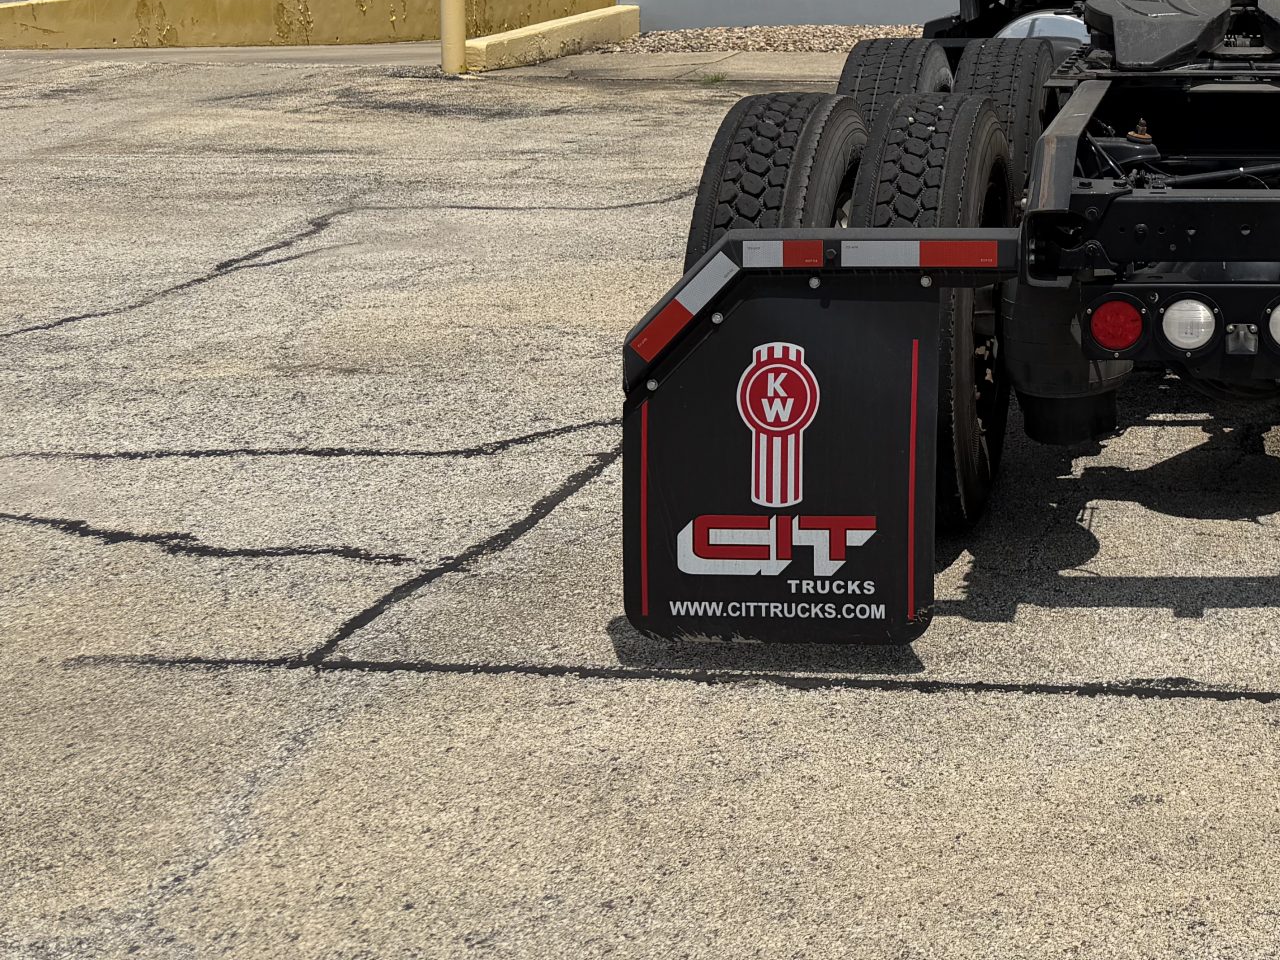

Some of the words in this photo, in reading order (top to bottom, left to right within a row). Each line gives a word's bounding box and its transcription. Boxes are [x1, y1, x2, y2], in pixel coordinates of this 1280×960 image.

[677, 514, 877, 577] CIT
[787, 579, 876, 595] TRUCKS
[669, 600, 887, 620] WWW.CITTRUCKS.COM
